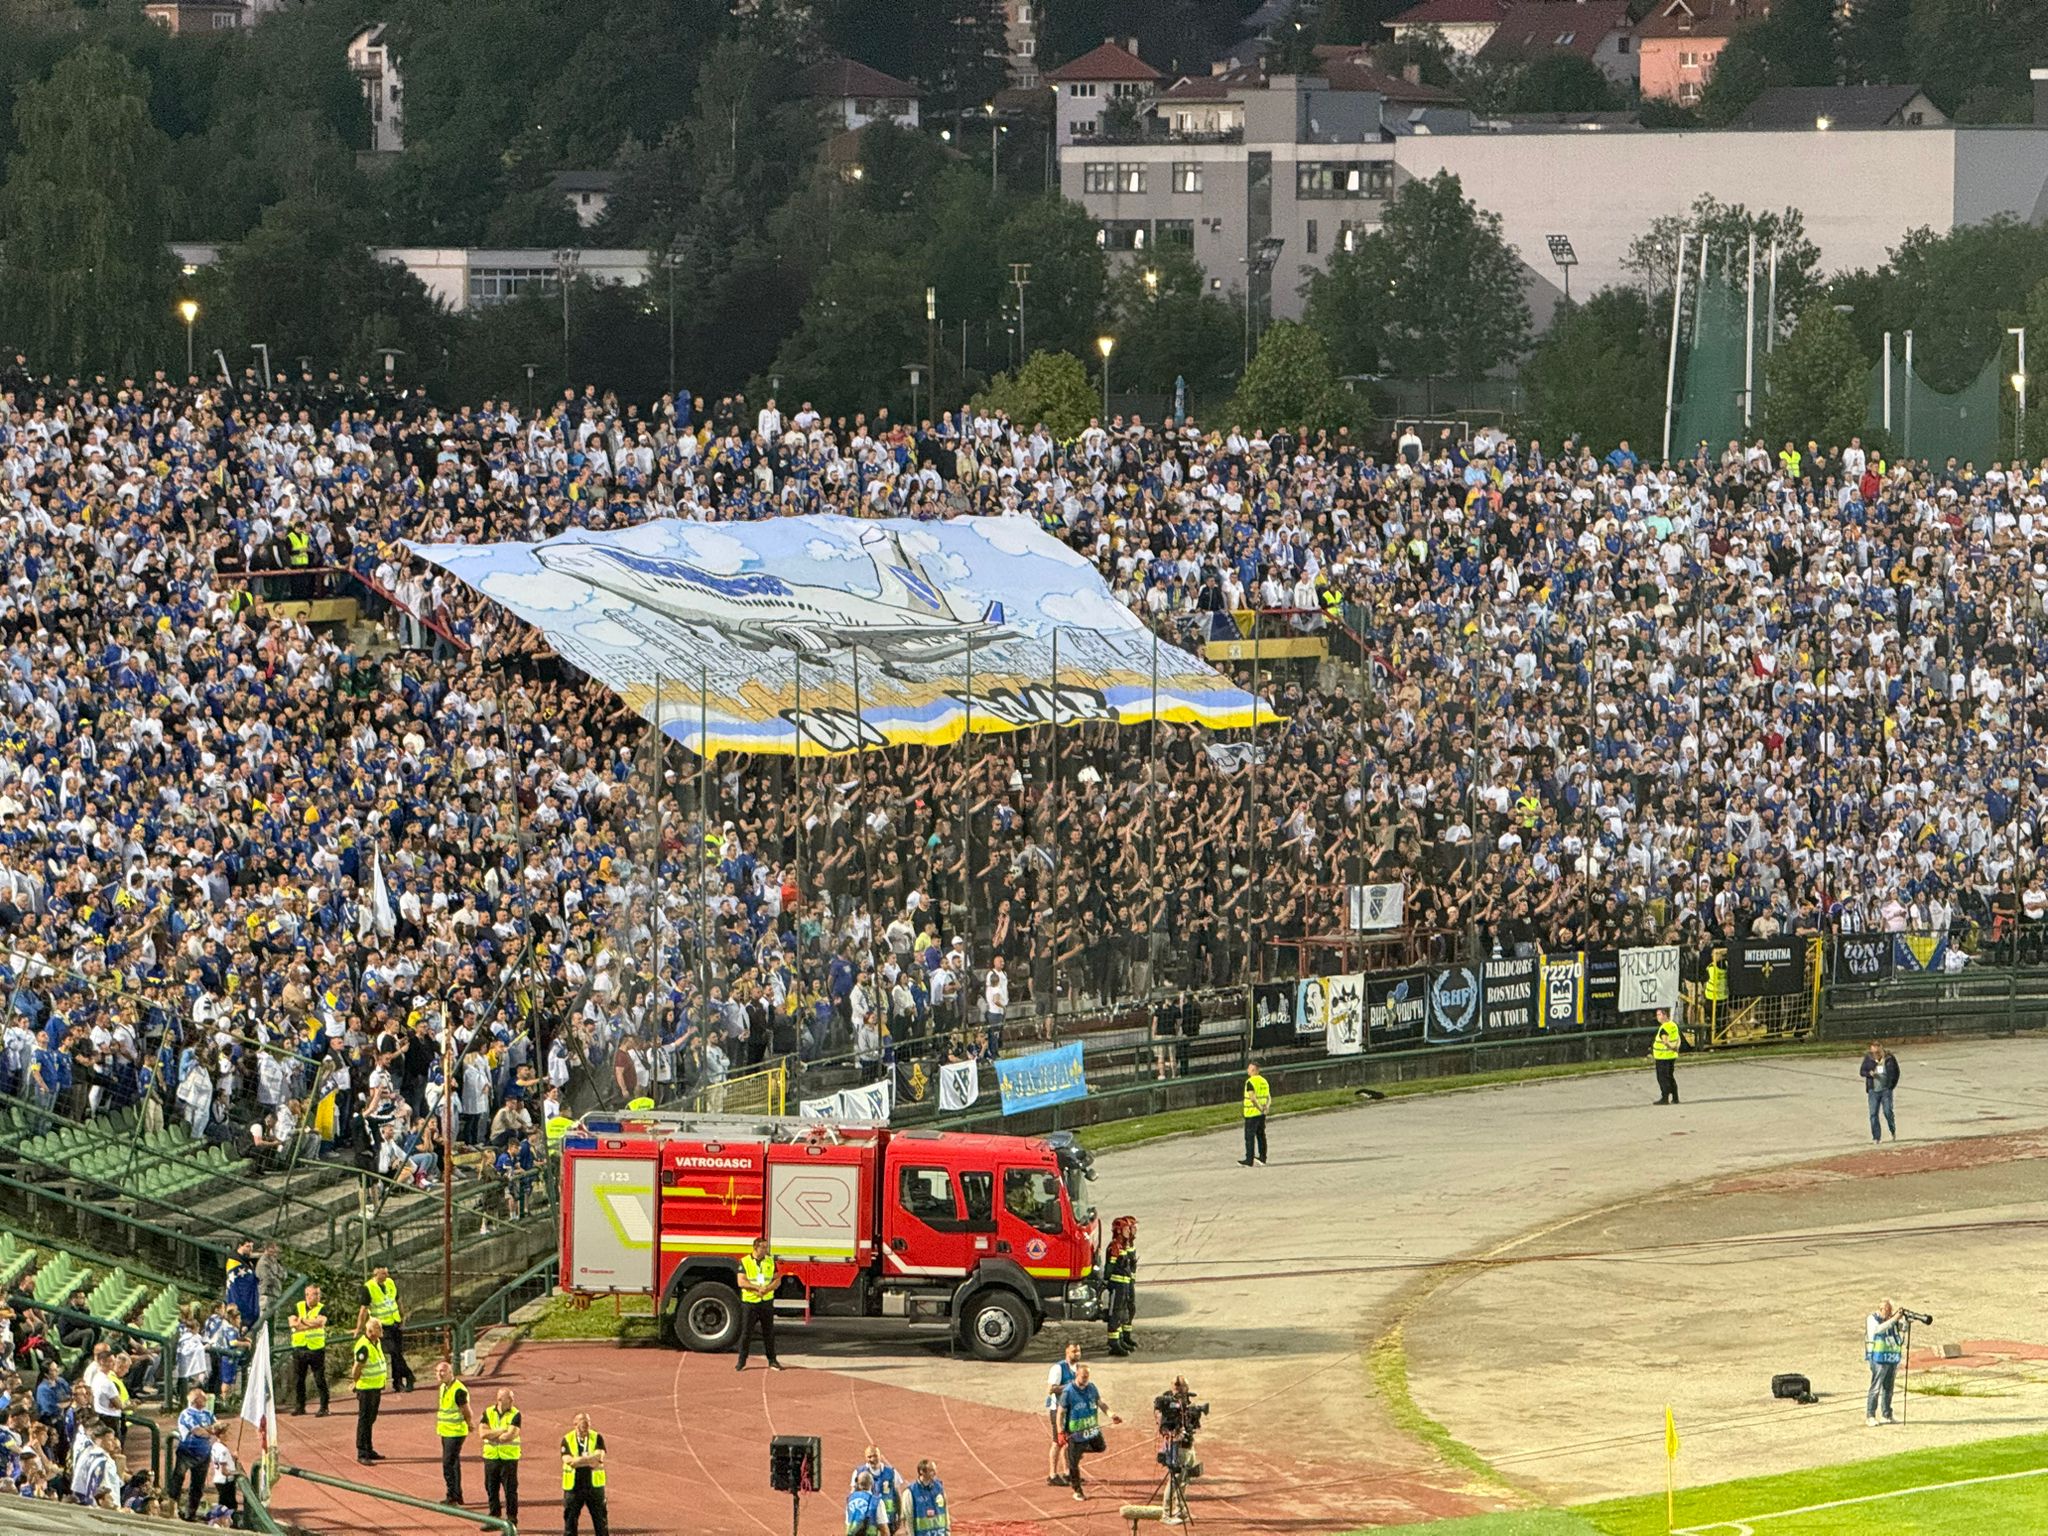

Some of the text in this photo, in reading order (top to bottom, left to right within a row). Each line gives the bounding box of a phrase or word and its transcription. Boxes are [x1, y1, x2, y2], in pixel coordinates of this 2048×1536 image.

[1744, 948, 1791, 962] INTERVENTNA
[1485, 959, 1533, 979] HARDCORE
[1541, 962, 1582, 981] 72270
[1440, 987, 1471, 1008] BHF
[1487, 982, 1531, 1004] BOSNIANS
[1396, 999, 1424, 1023] YOUTH
[1489, 1008, 1528, 1028] ON TOUR
[675, 1156, 752, 1169] VATROGASCI
[610, 1172, 630, 1182] 123
